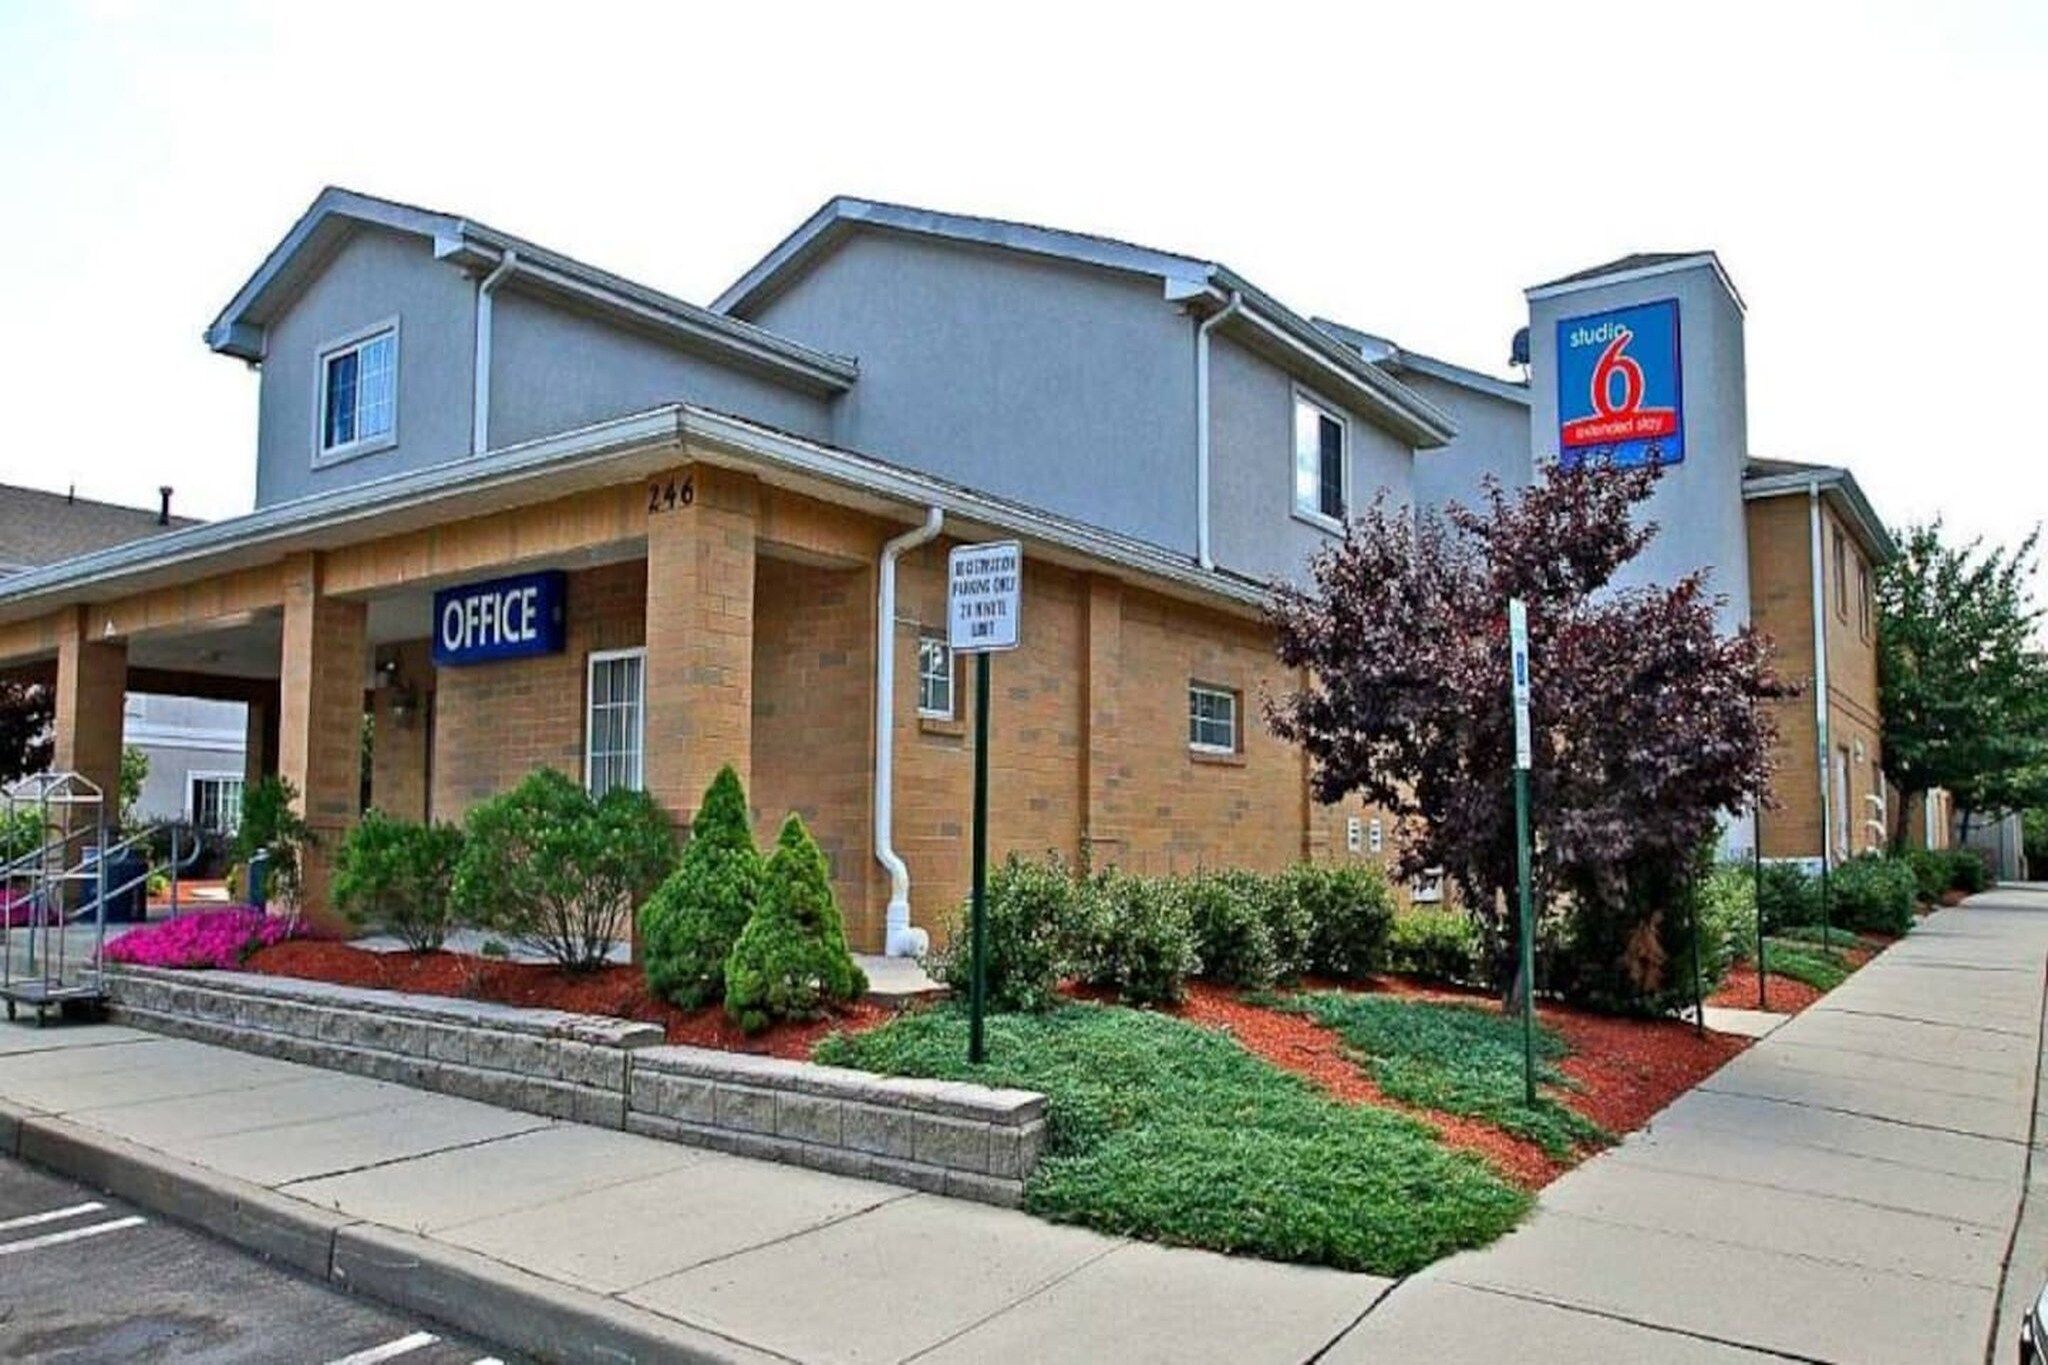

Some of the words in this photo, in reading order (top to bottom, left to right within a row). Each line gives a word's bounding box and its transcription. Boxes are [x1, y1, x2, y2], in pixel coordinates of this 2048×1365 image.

[1570, 323, 1627, 347] studio
[1591, 330, 1645, 416] 6
[1636, 416, 1663, 432] stay
[648, 475, 694, 514] 246
[442, 587, 537, 651] OFFICE
